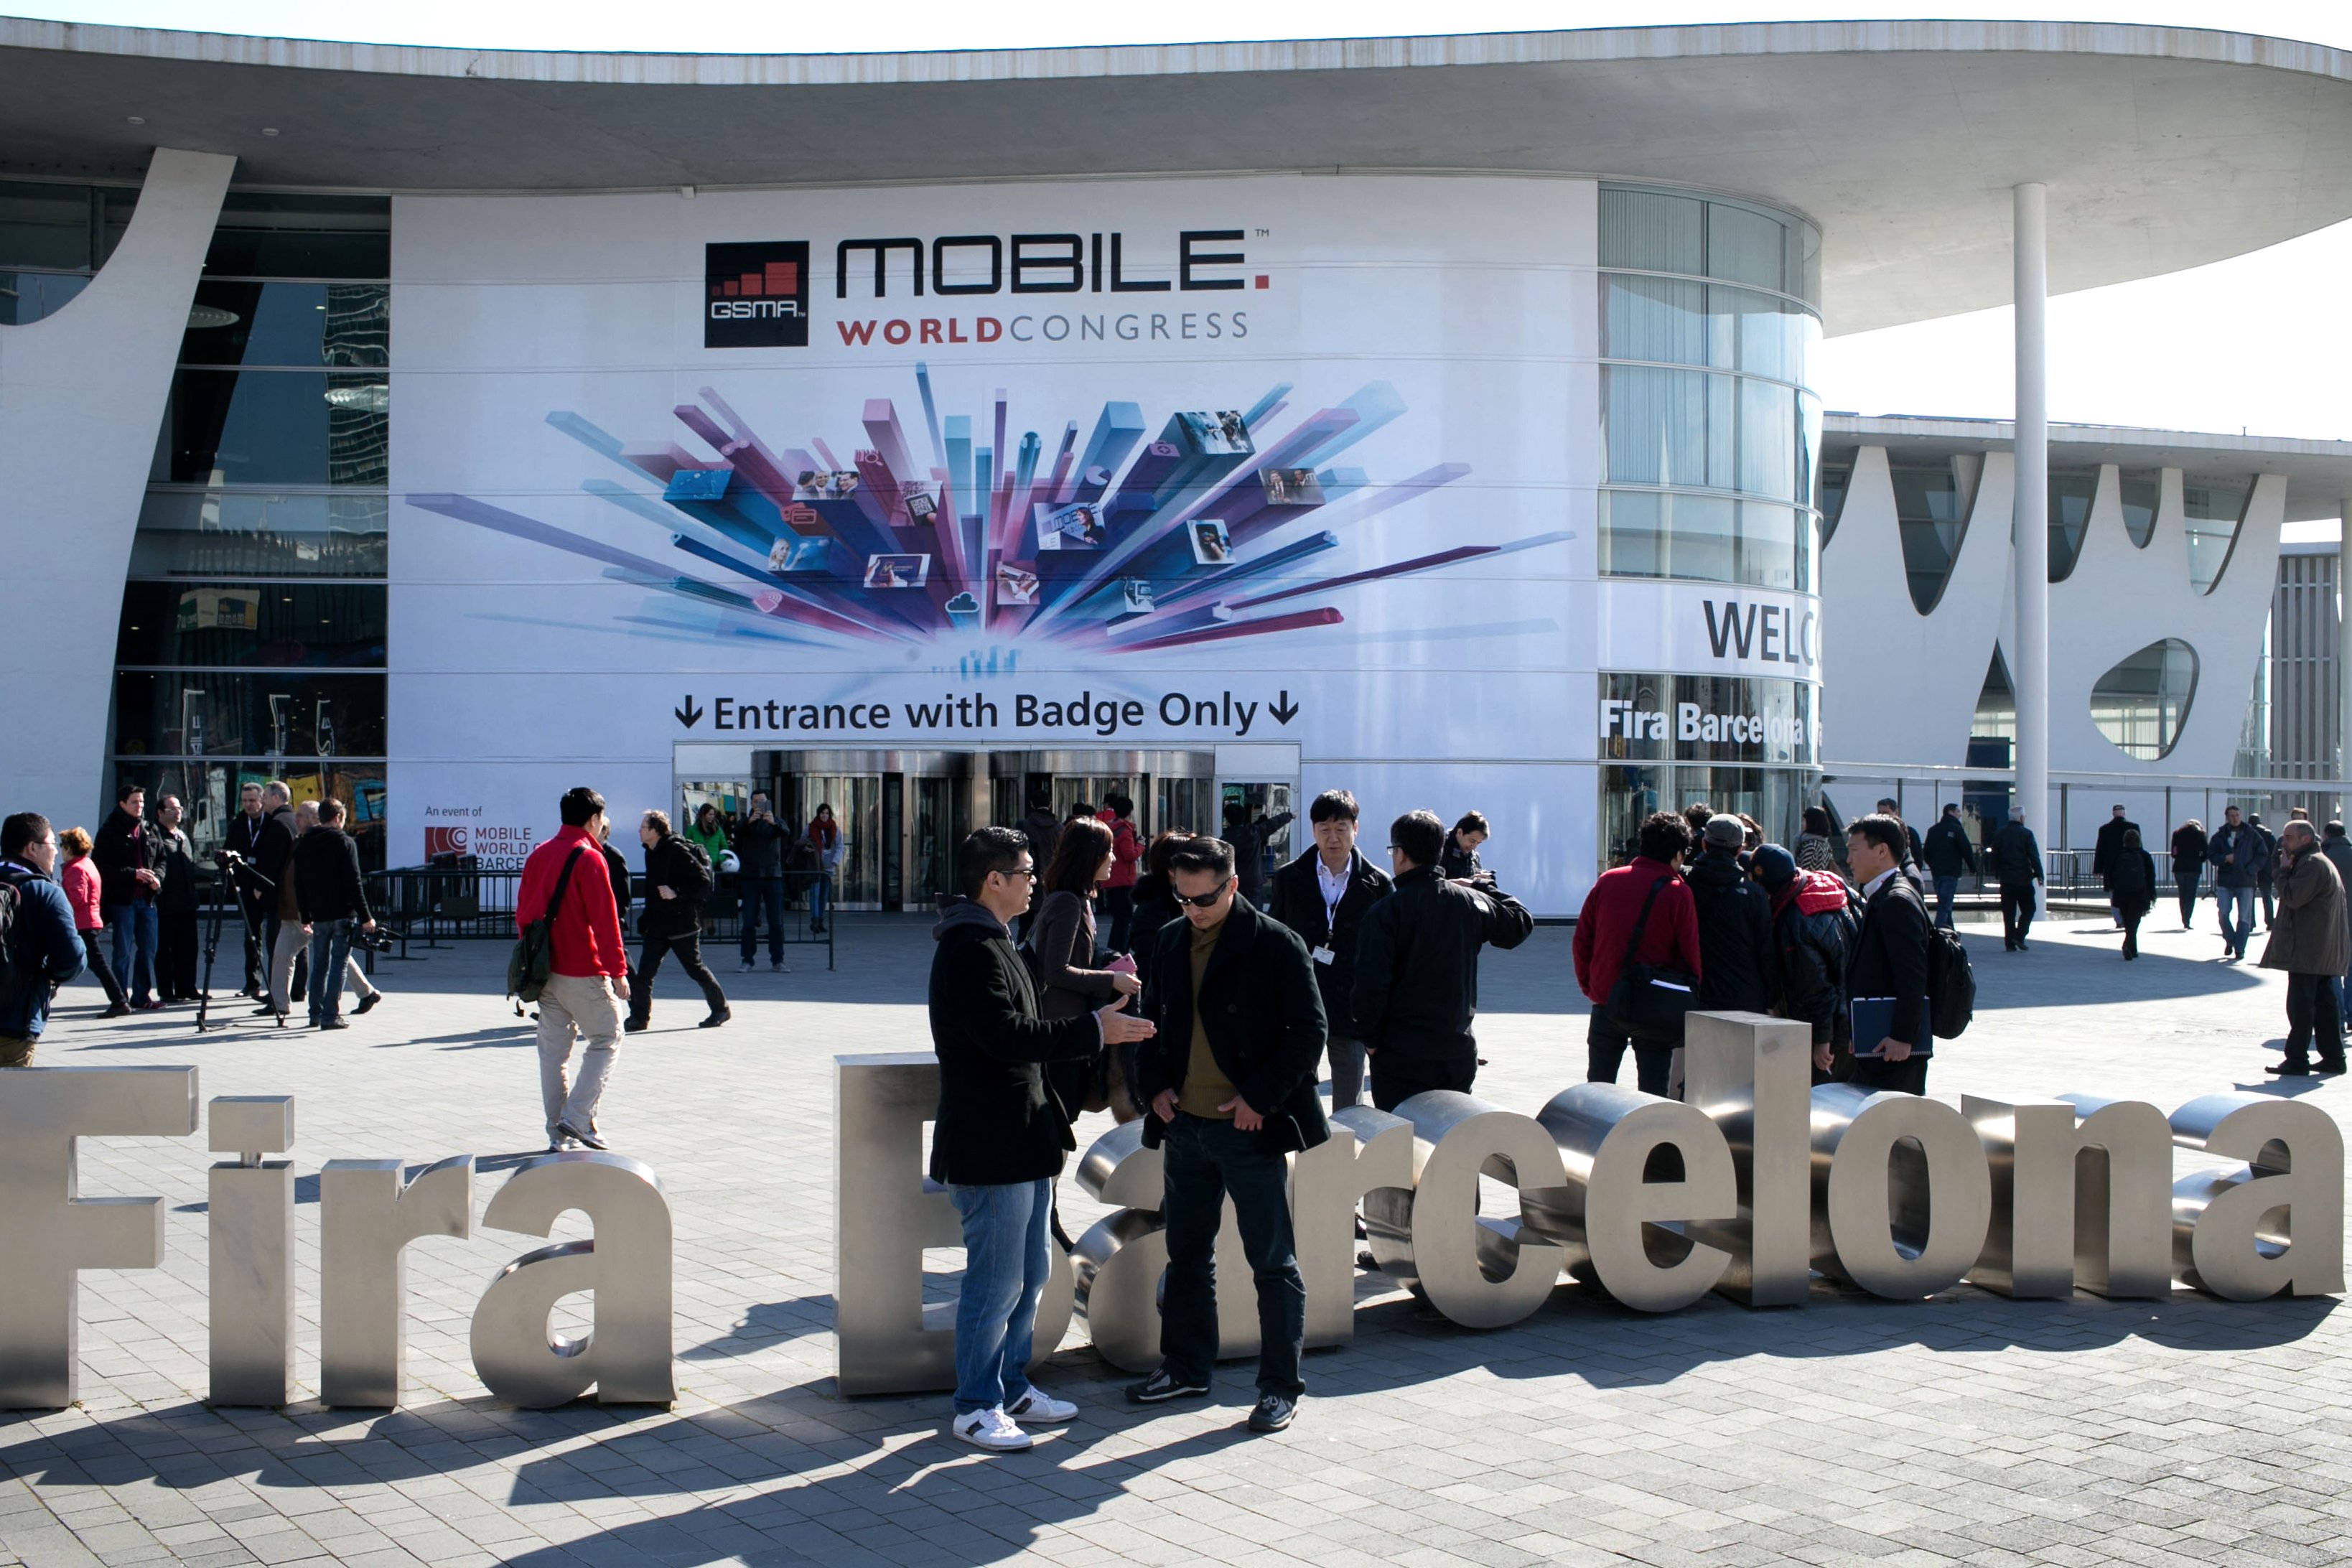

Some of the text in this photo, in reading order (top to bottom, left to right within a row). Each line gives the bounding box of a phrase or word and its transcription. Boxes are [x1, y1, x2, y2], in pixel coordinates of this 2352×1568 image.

[711, 300, 798, 319] GSMA
[714, 691, 1259, 737] Entrance with Badge Only
[1600, 699, 1669, 740] Fira
[1678, 701, 1803, 745] Barcelona
[424, 805, 483, 817] An event of
[475, 826, 532, 840] MOBILE
[474, 842, 528, 855] WORLD
[476, 857, 528, 870] BARCE
[0, 1065, 679, 1410] Fira
